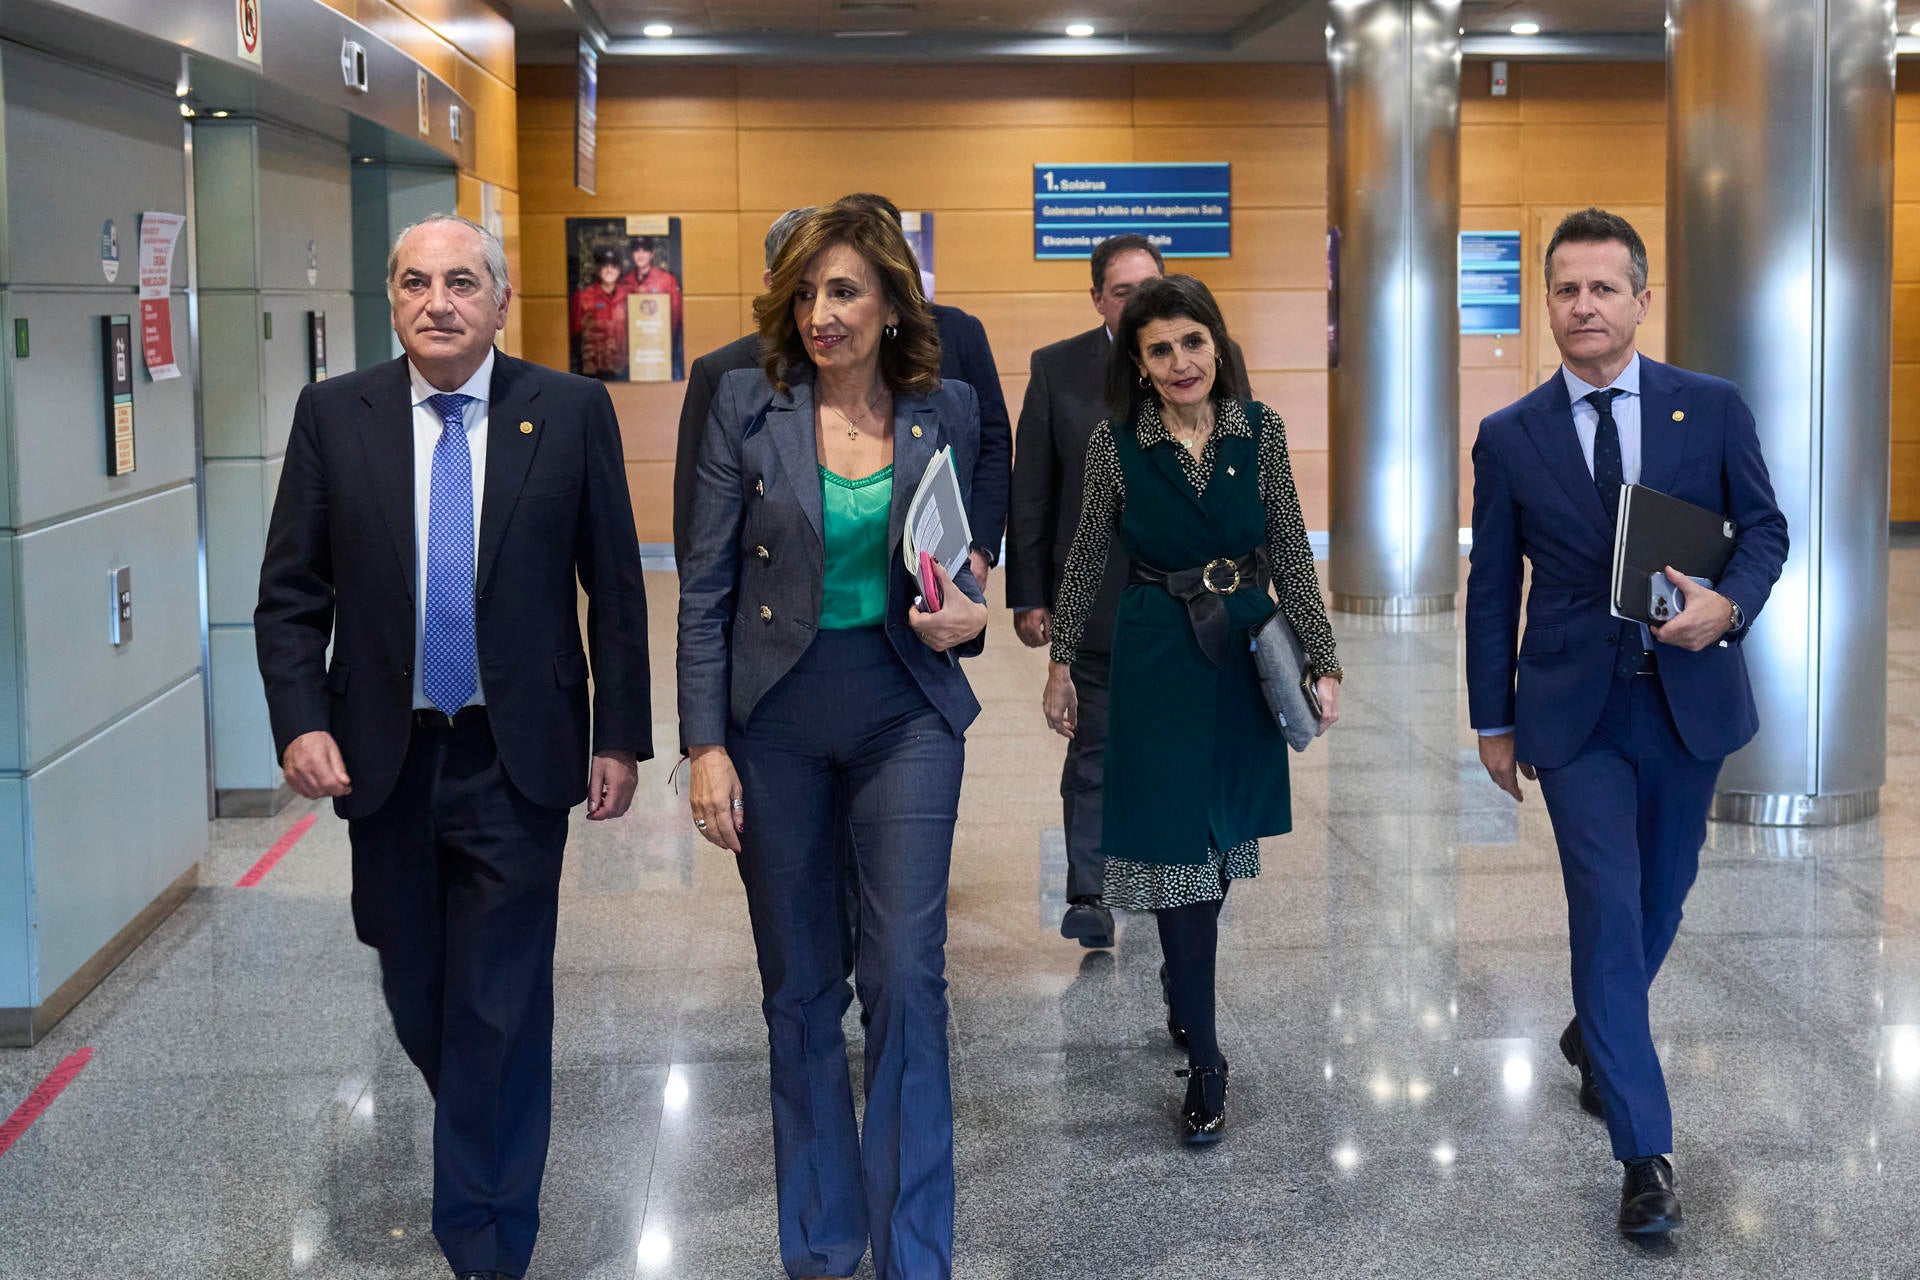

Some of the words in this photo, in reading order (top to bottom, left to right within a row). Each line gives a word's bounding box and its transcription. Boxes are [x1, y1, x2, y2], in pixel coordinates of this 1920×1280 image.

[1043, 171, 1059, 191] 1.
[1060, 179, 1107, 191] Solairua
[1042, 205, 1096, 217] Gobernantza
[1097, 205, 1130, 216] Publiko
[1131, 206, 1145, 216] eta
[1146, 205, 1200, 218] Autogobernu
[1201, 204, 1223, 216] Saila
[1042, 235, 1091, 247] Ekonomia
